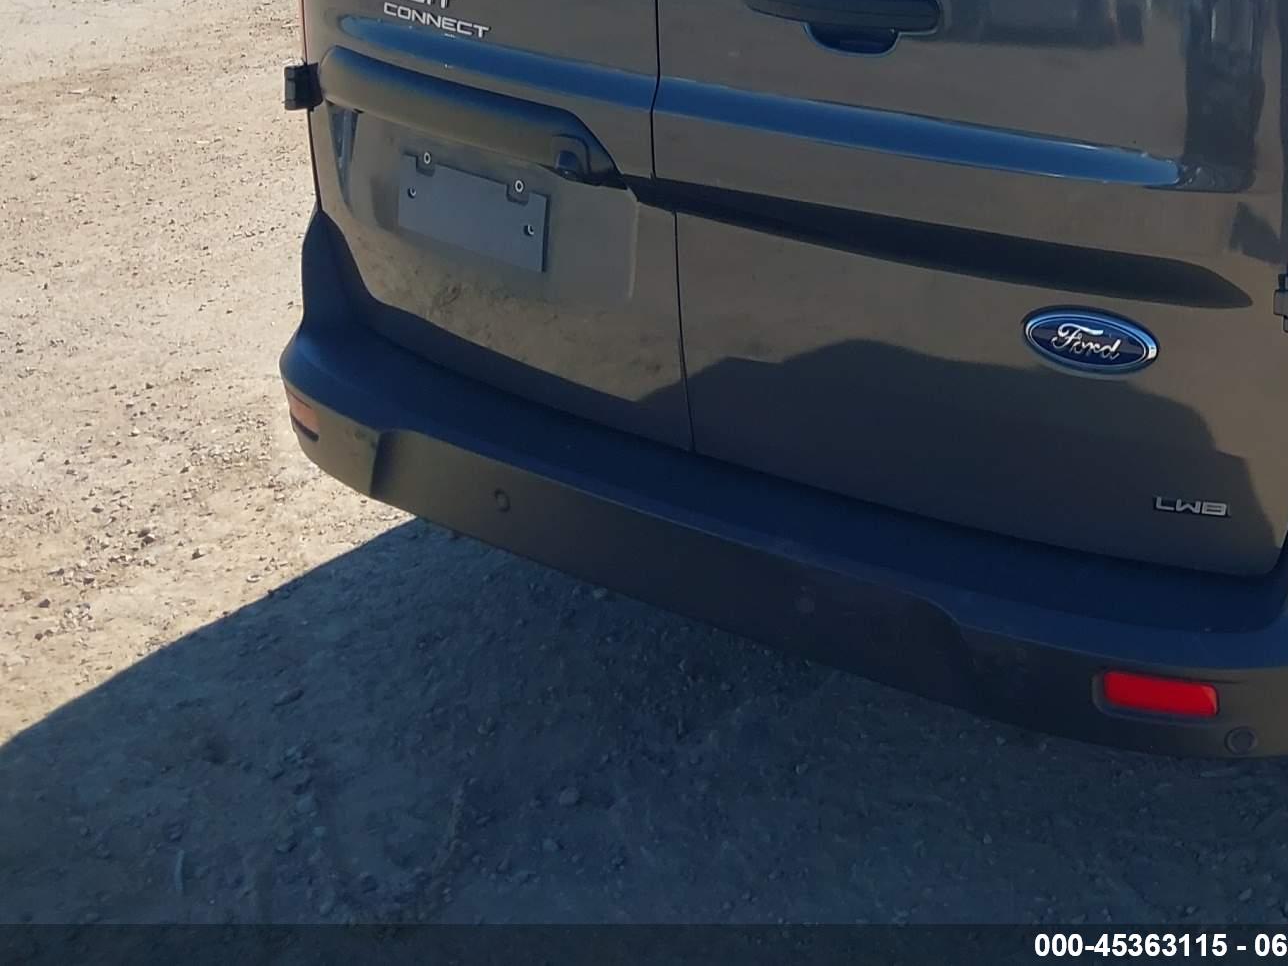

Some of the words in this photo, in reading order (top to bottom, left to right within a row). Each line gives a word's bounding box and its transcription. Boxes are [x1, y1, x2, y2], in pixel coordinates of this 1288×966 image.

[383, 2, 489, 38] CONNECT
[1051, 323, 1121, 361] Ford
[1155, 496, 1228, 516] LWB
